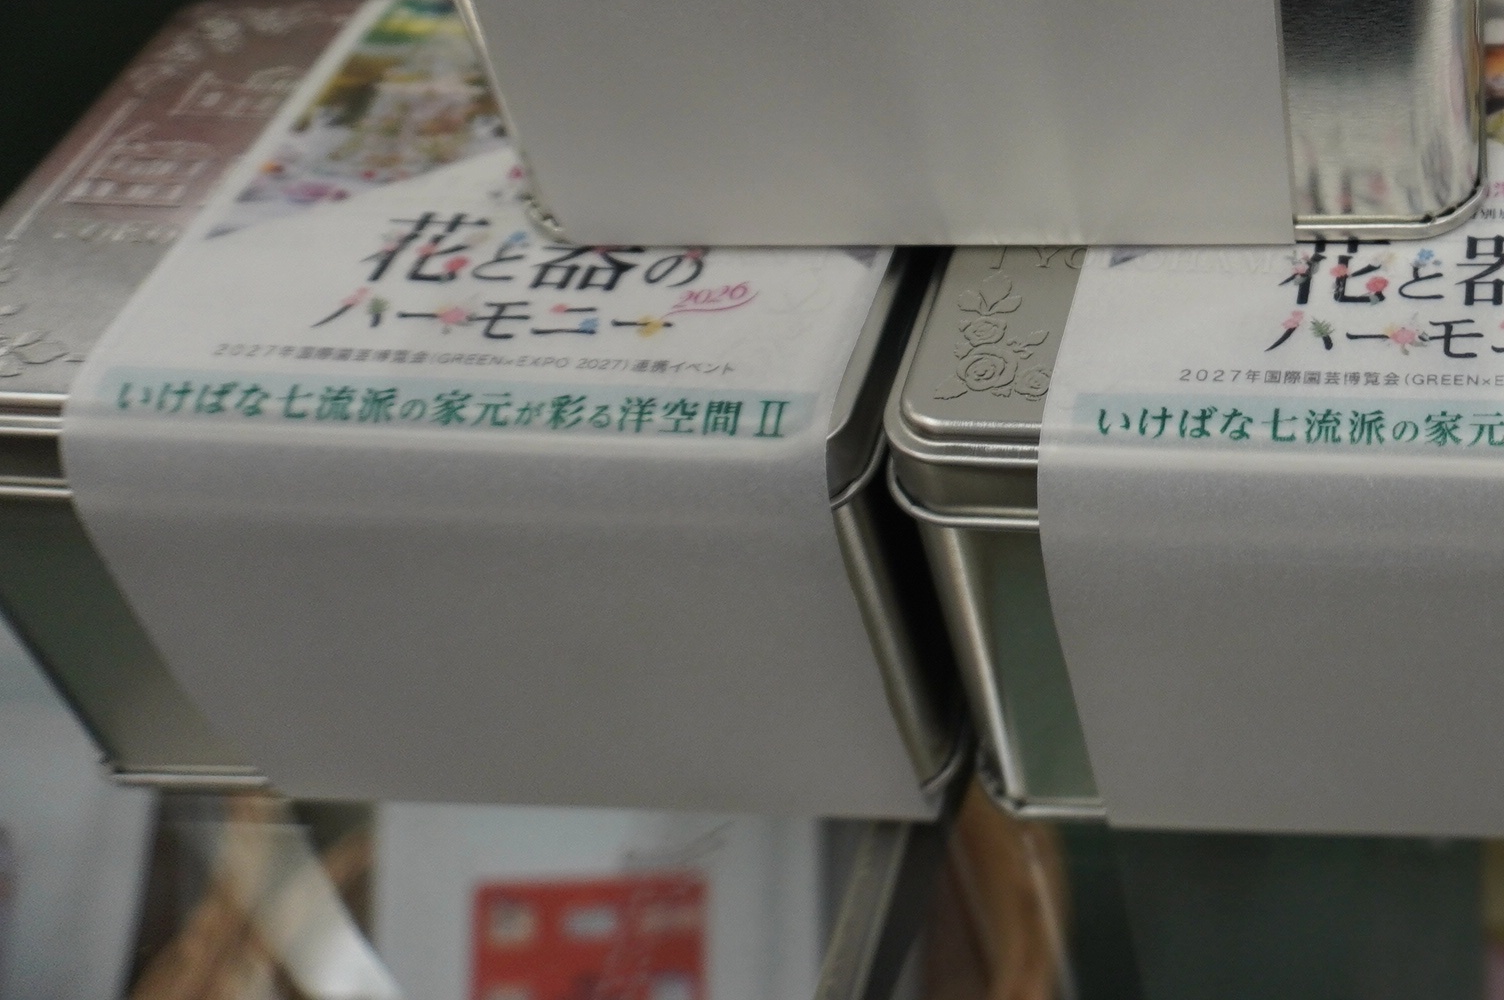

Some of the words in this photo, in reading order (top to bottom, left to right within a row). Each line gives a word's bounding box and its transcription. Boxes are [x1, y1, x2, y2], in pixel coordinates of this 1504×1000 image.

[309, 287, 675, 340] ハーモニー
[671, 281, 749, 309] 2026
